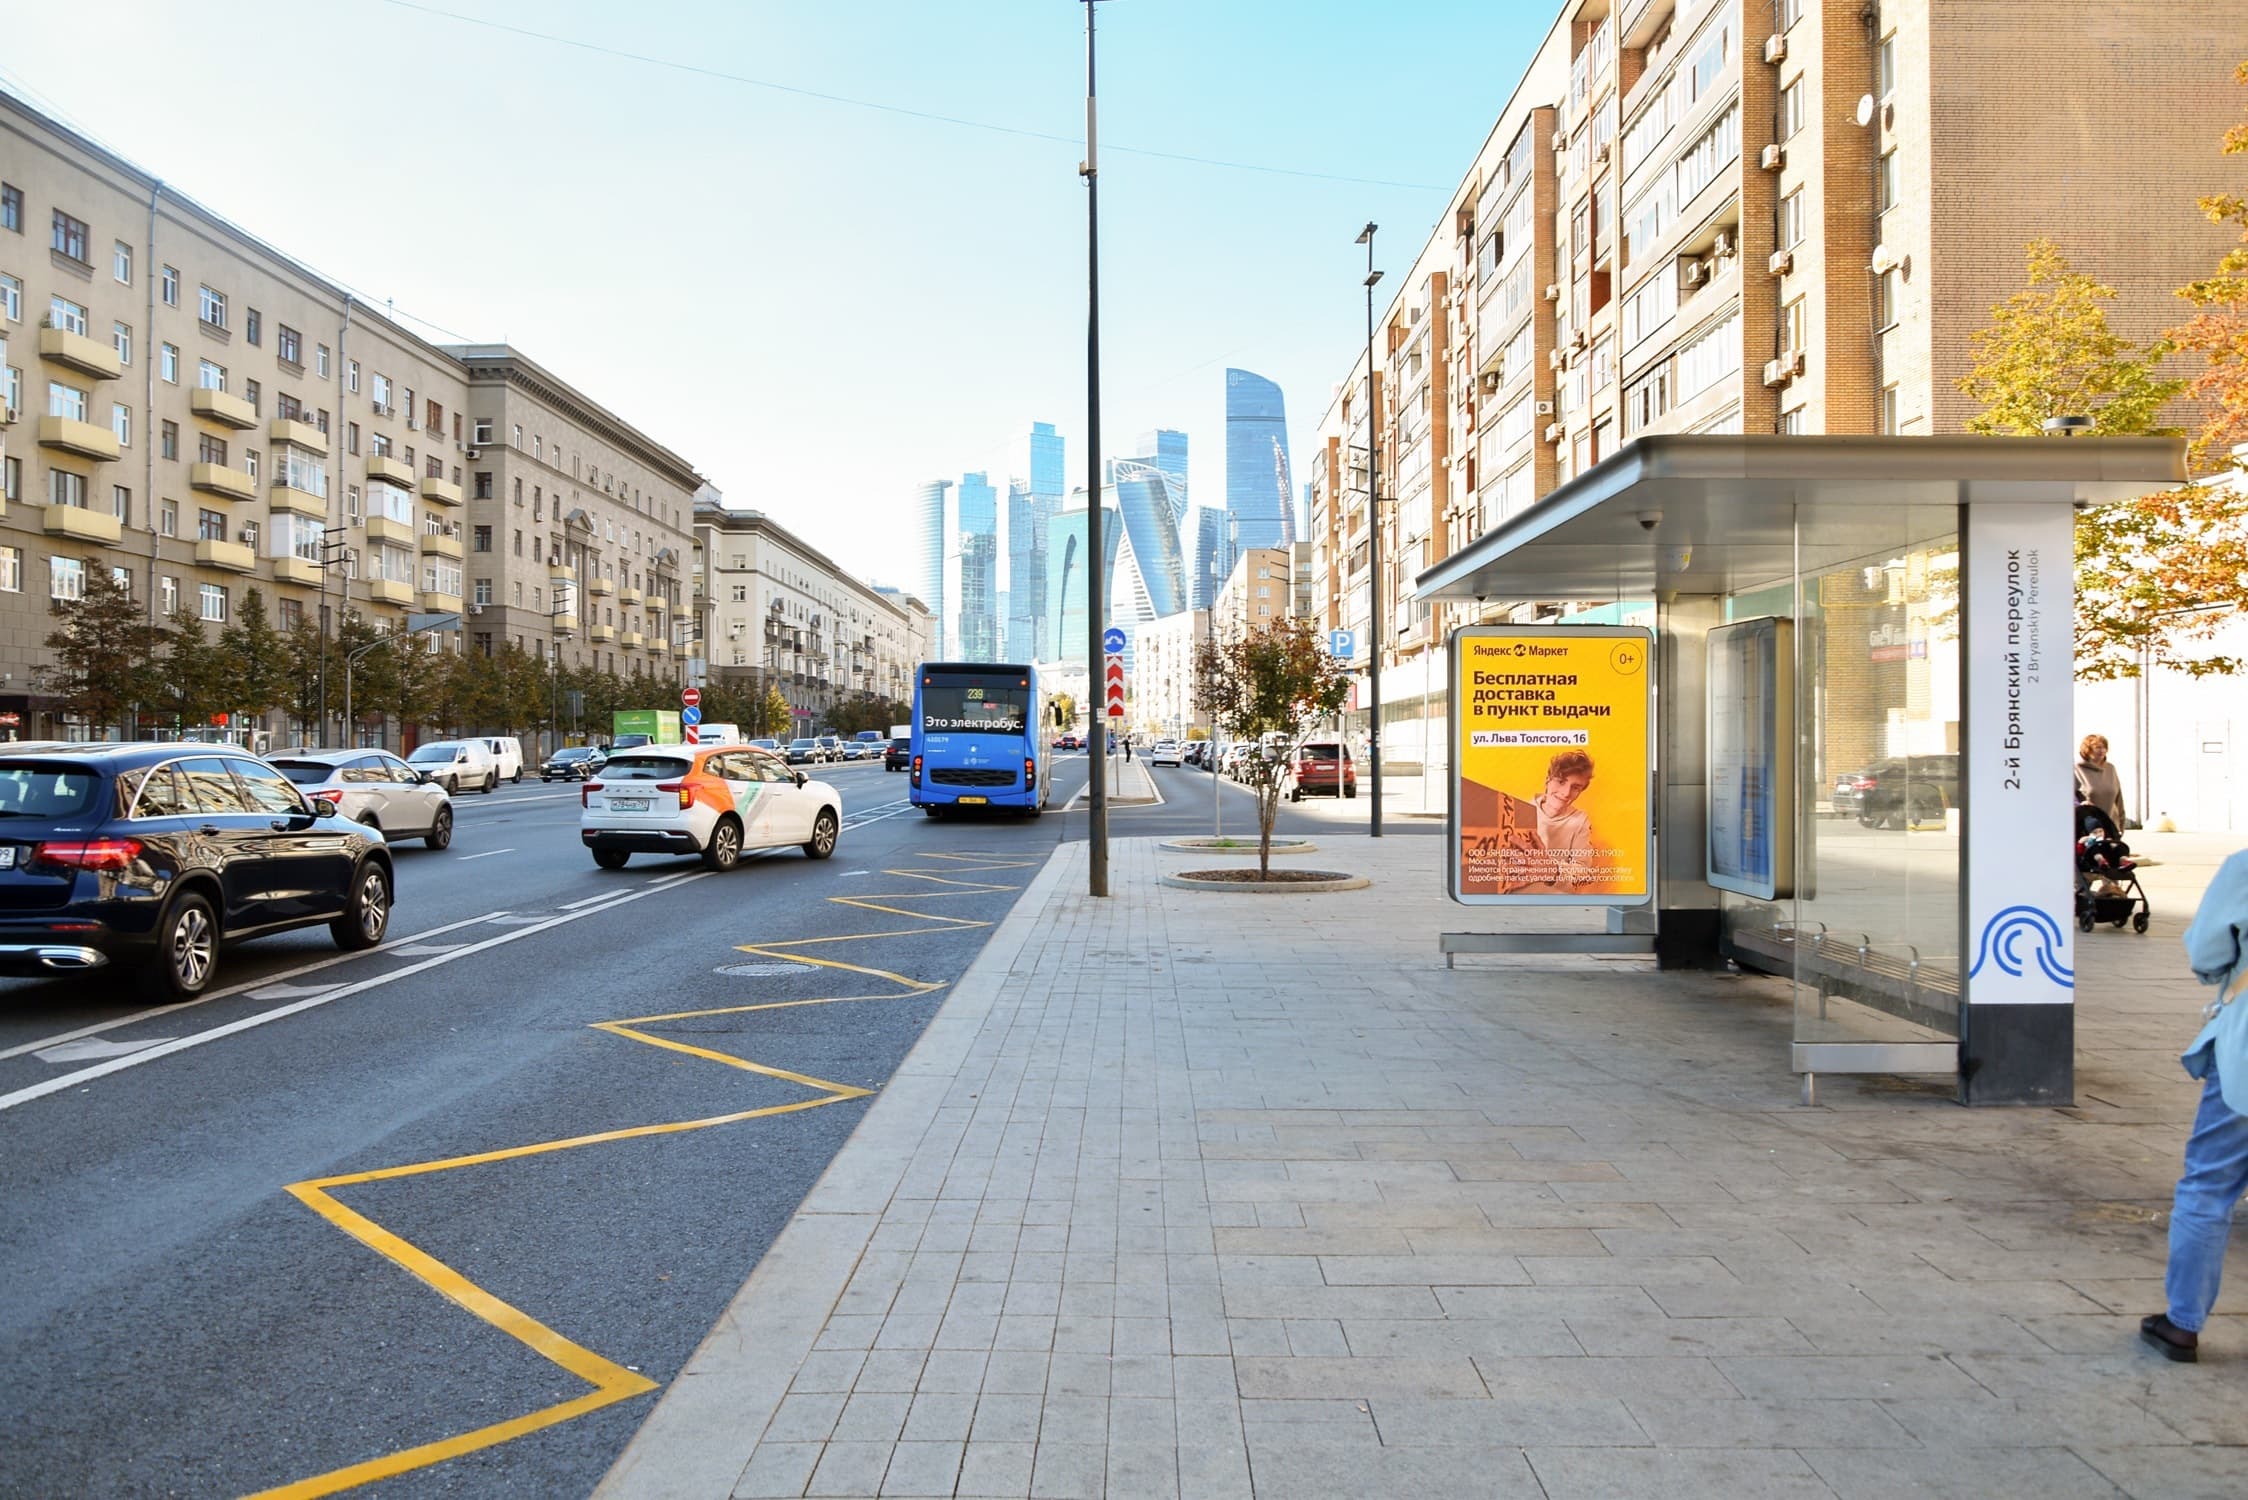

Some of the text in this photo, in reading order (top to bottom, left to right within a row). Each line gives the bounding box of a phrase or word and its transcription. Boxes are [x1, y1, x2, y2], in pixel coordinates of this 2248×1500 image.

[2026, 549, 2041, 684] 2 Bryanskiy Pereulok
[1473, 645, 1569, 657] Яндекс Маркет
[1619, 653, 1635, 665] 0+
[2003, 549, 2024, 790] 2-й Брянский переулок
[1473, 671, 1578, 686] Бесплатная
[967, 688, 984, 700] 239
[1473, 689, 1555, 703] доставка
[1473, 705, 1611, 719] в пункт выдачи
[925, 715, 1024, 731] Это электробус.
[1473, 733, 1587, 745] ул. Льва Толстого, 16
